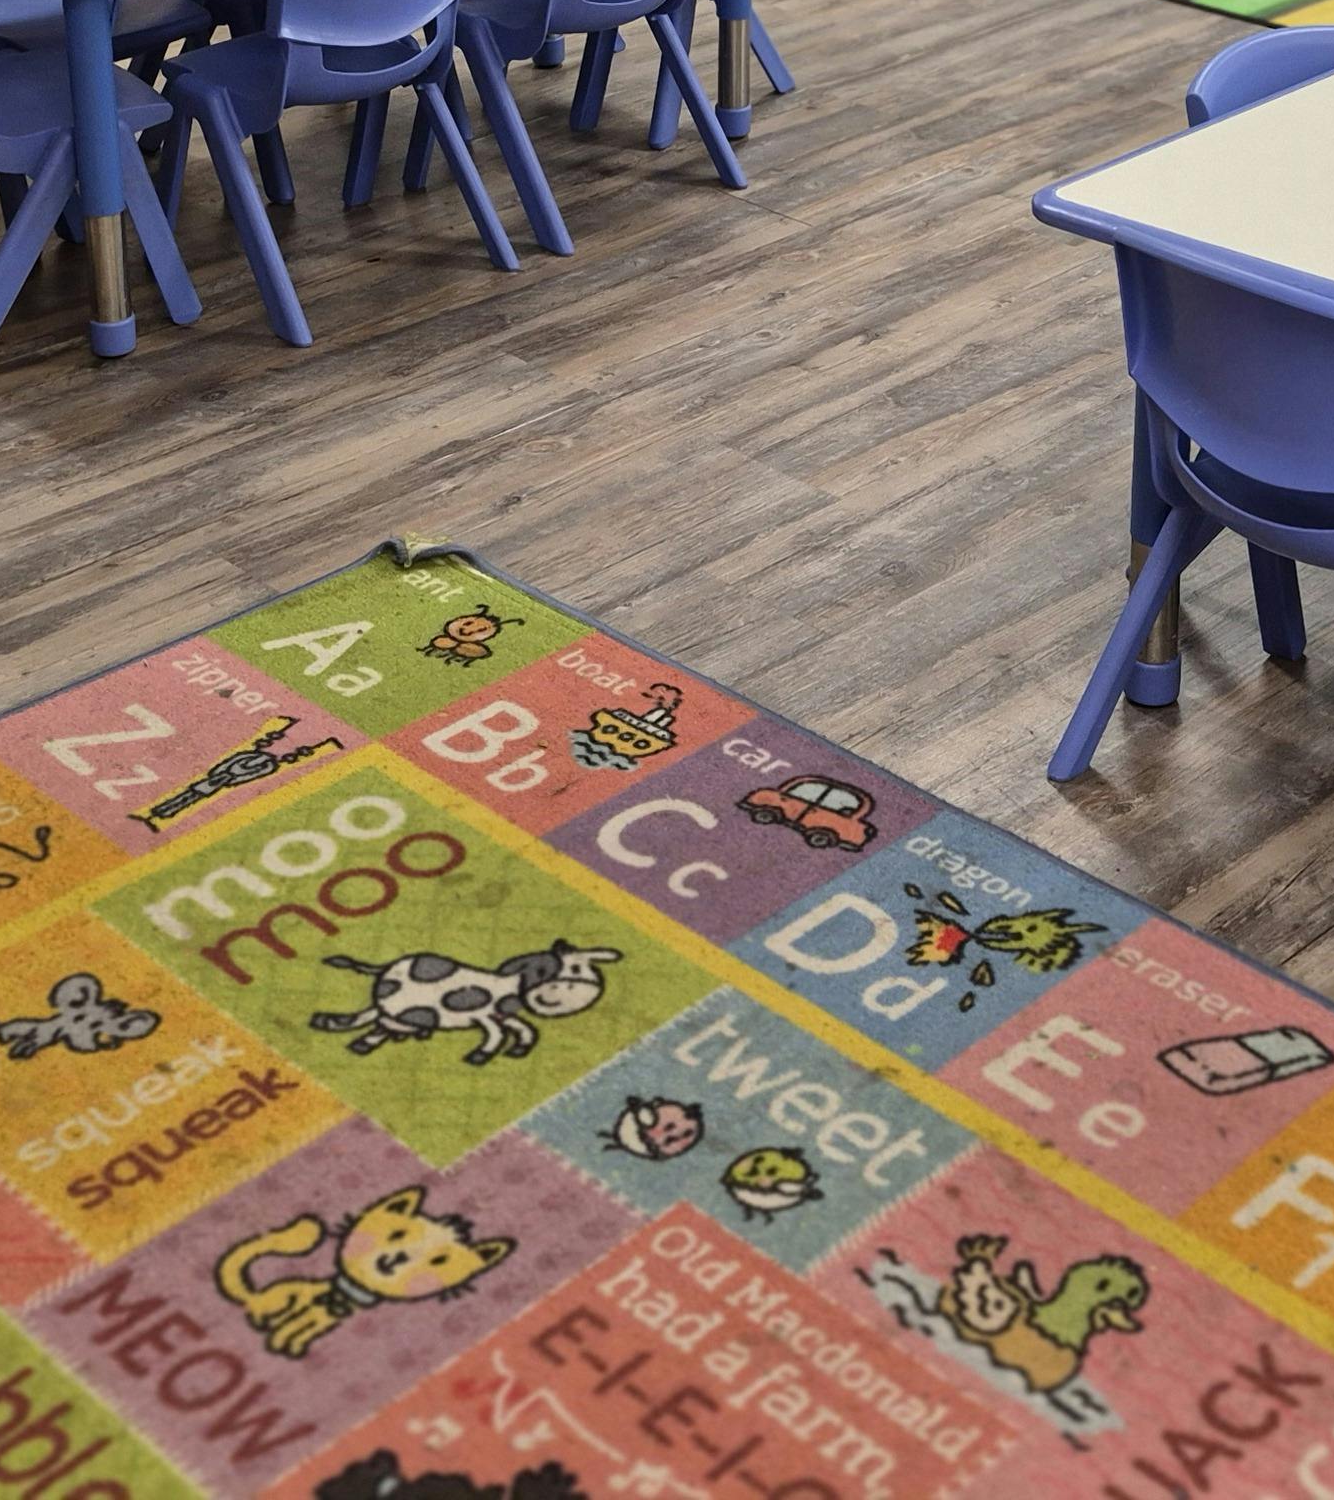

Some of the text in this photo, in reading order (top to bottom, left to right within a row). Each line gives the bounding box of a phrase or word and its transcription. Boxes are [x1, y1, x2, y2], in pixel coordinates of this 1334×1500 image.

[402, 565, 466, 604] ant
[172, 652, 280, 715] zipper
[557, 649, 637, 697] boat
[422, 700, 548, 792] Bb
[722, 736, 791, 774] car
[143, 795, 406, 940] moo
[200, 832, 466, 986] moo
[905, 832, 1034, 908] dragon
[767, 893, 949, 1021] Dd
[1110, 946, 1253, 1023] eraser
[15, 1034, 245, 1172] squeak
[66, 1065, 300, 1212] squeak
[674, 1013, 927, 1186] tweet
[982, 1014, 1147, 1148] Ee
[60, 1268, 317, 1466] MEOW
[598, 1257, 722, 1354] had
[703, 1341, 753, 1384] a
[651, 1225, 979, 1463] Old Macdonald
[529, 1306, 841, 1500] E-I-E-I-
